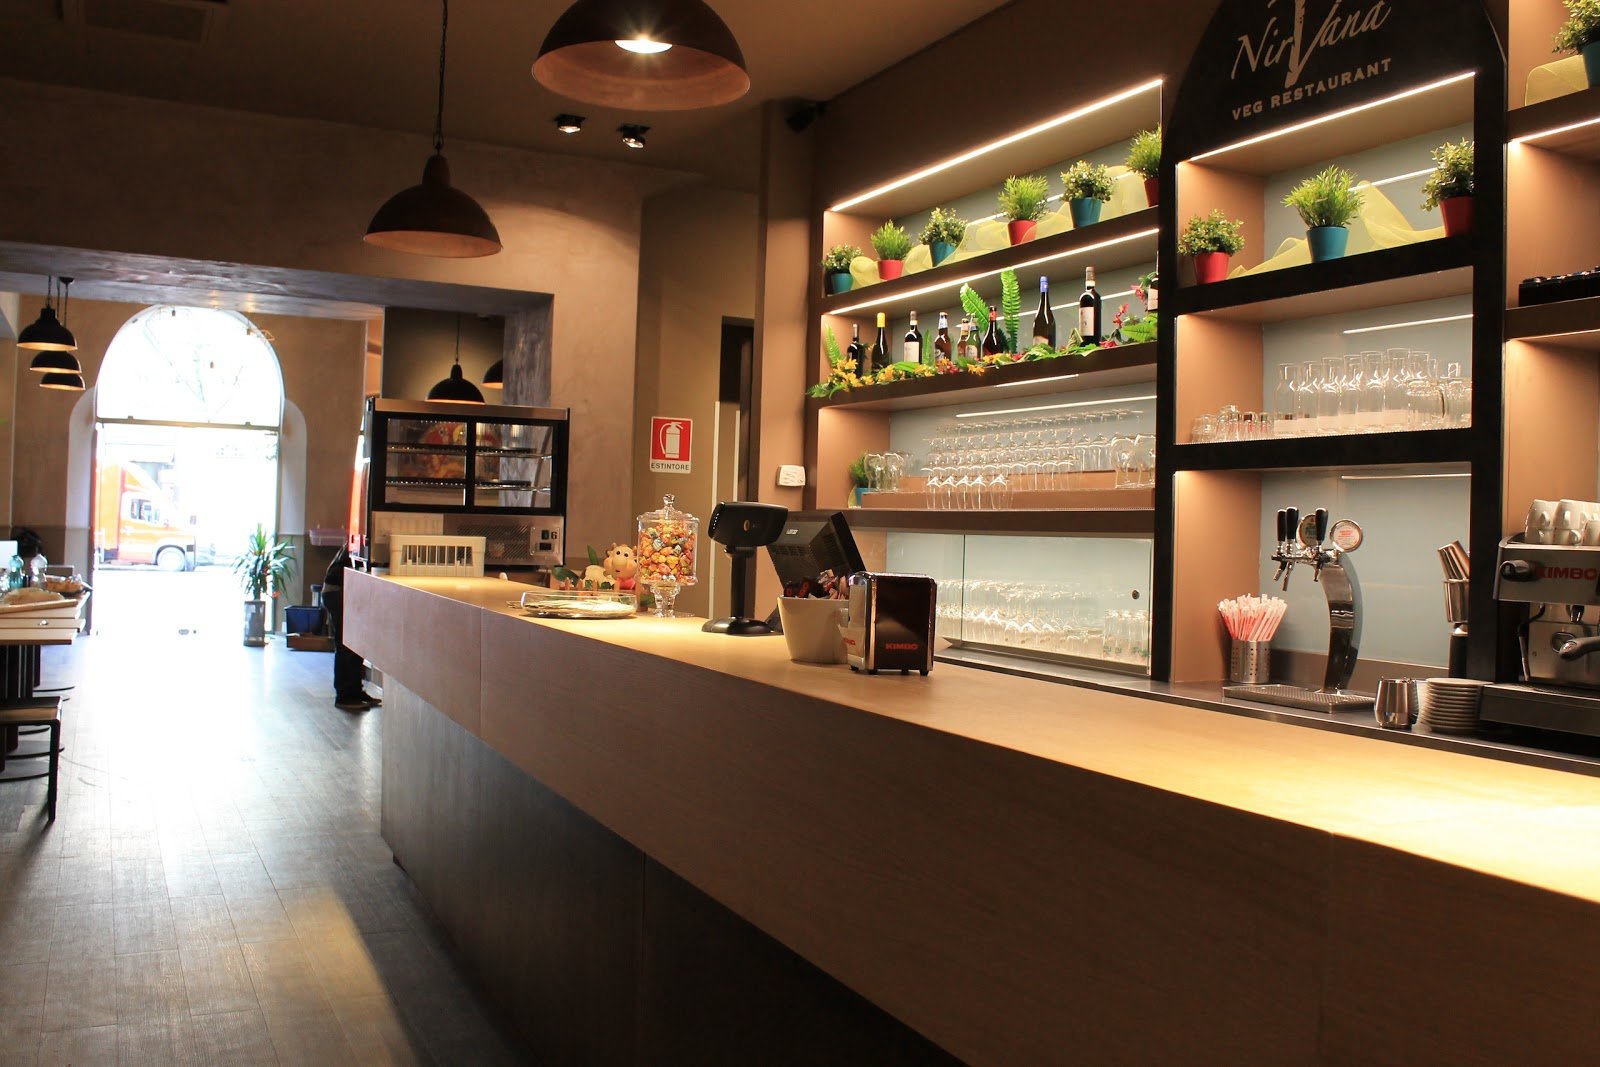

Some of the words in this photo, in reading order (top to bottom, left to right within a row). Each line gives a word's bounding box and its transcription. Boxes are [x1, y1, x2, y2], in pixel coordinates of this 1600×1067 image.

[1232, 101, 1263, 120] VEG
[1270, 58, 1392, 108] RESTAURANT
[650, 462, 690, 470] ESTINTORE
[885, 642, 918, 650] KIMBO
